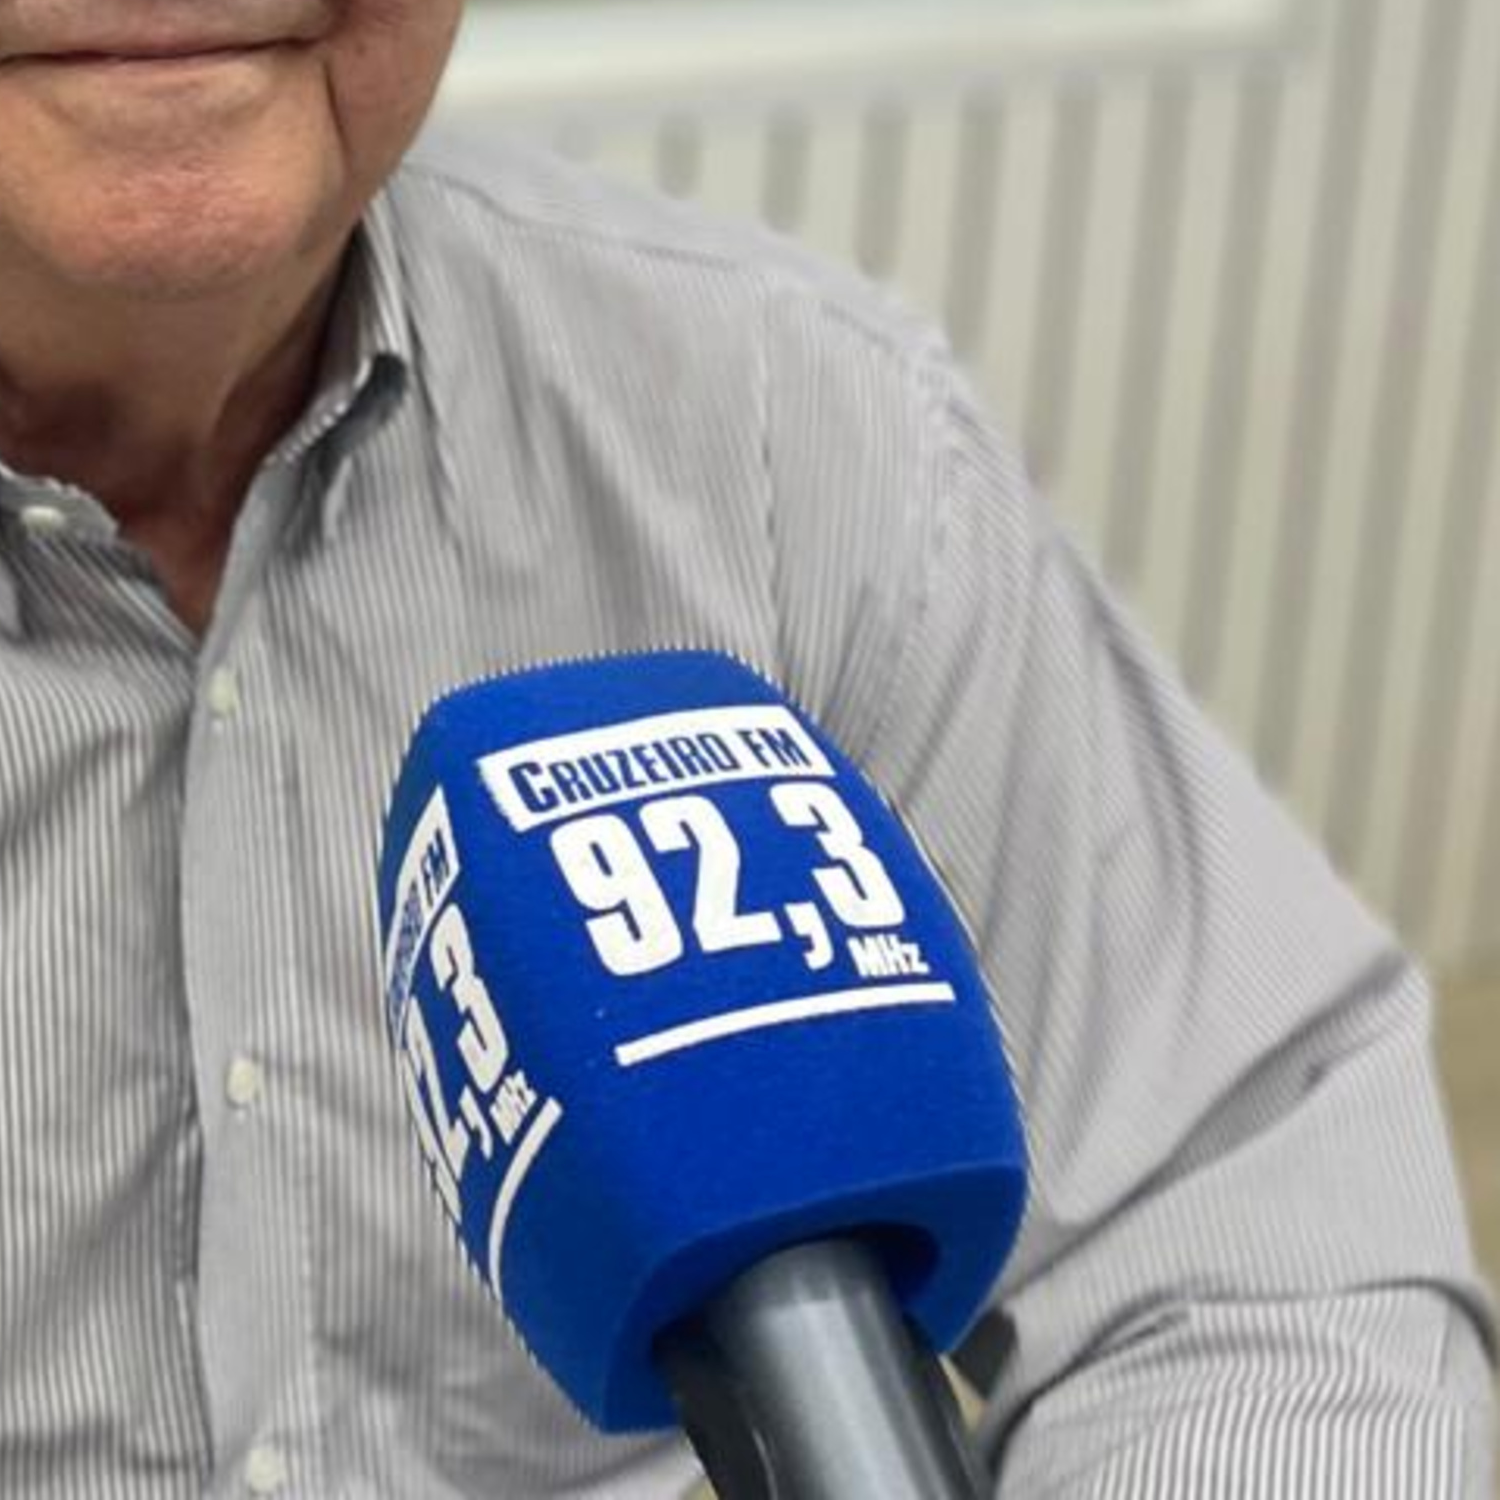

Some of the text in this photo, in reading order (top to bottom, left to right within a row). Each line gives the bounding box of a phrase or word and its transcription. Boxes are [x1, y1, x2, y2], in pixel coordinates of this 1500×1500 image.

[508, 728, 811, 814] CRUZEIRO FM
[550, 782, 905, 976] 92,3
[847, 933, 930, 977] MHz
[403, 902, 508, 1225] 2,3
